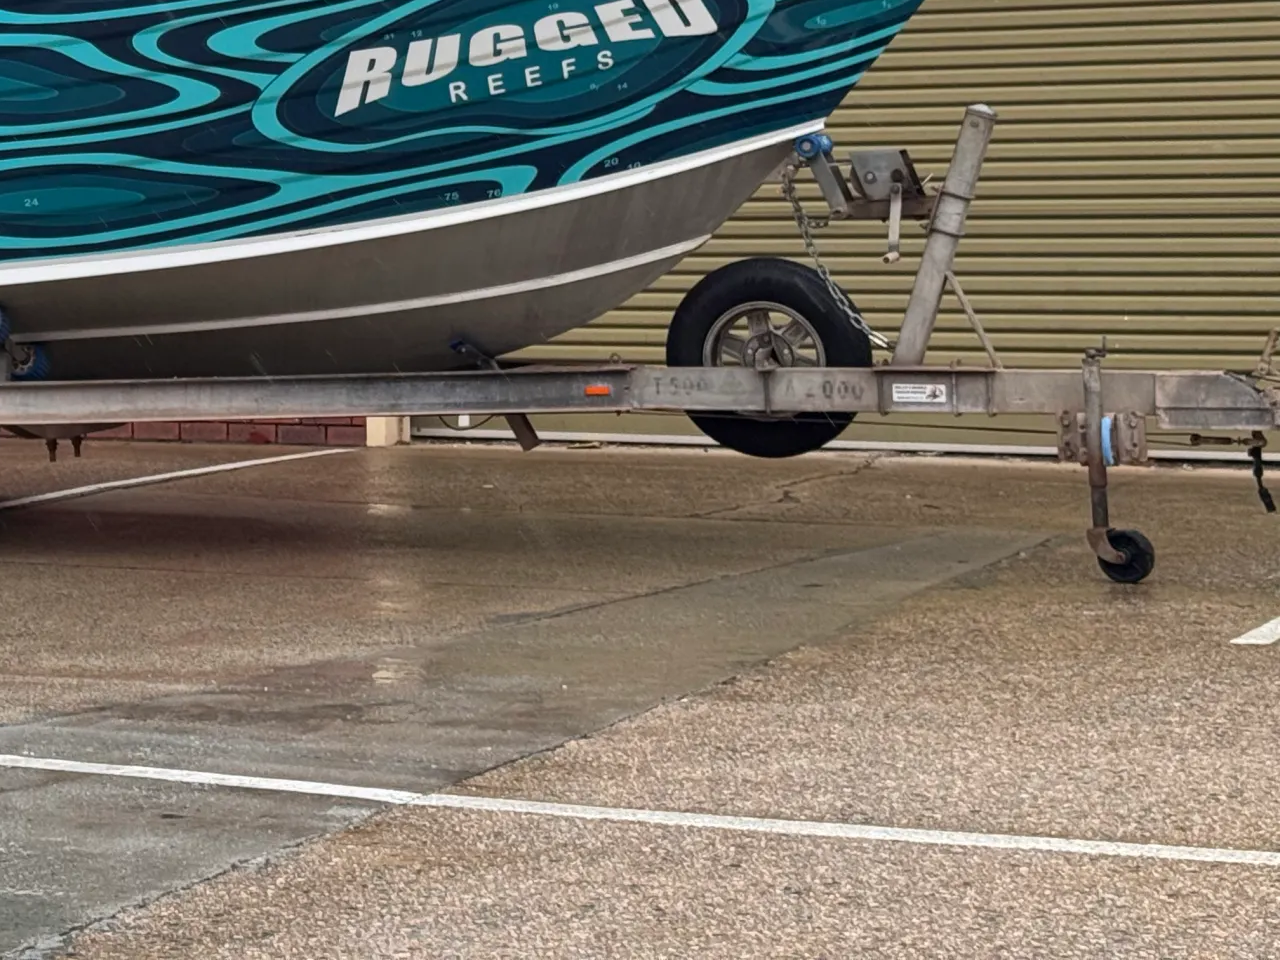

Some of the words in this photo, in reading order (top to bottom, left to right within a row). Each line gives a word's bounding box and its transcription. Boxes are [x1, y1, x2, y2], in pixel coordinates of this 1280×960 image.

[448, 50, 615, 103] REEFS
[604, 157, 619, 168] 20
[24, 198, 39, 207] 24
